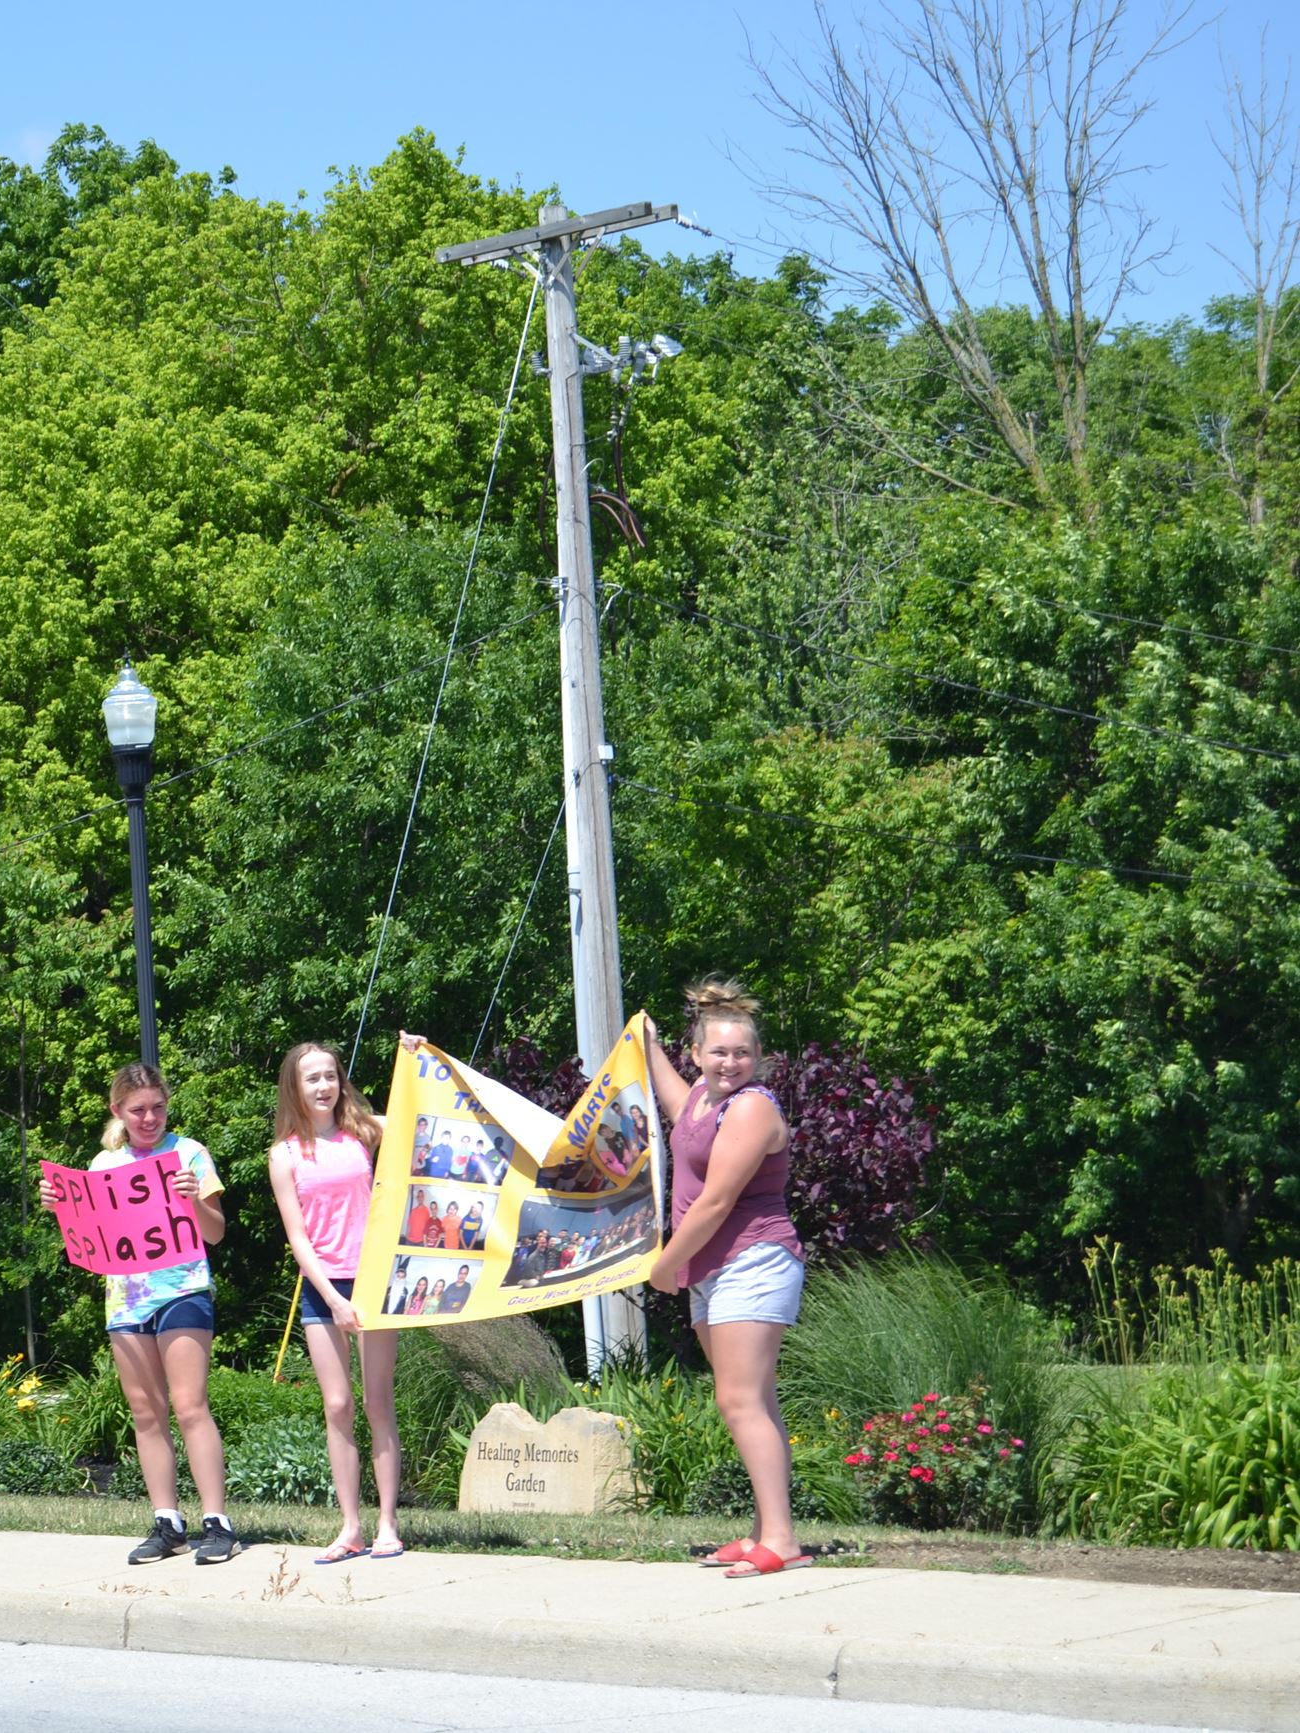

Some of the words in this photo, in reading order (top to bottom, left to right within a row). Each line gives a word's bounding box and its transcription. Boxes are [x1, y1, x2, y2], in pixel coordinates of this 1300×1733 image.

[417, 1054, 452, 1081] TO
[67, 1206, 198, 1269] Splash
[477, 1442, 521, 1468] Healing
[524, 1442, 579, 1463] Memories
[506, 1472, 546, 1493] Garden
